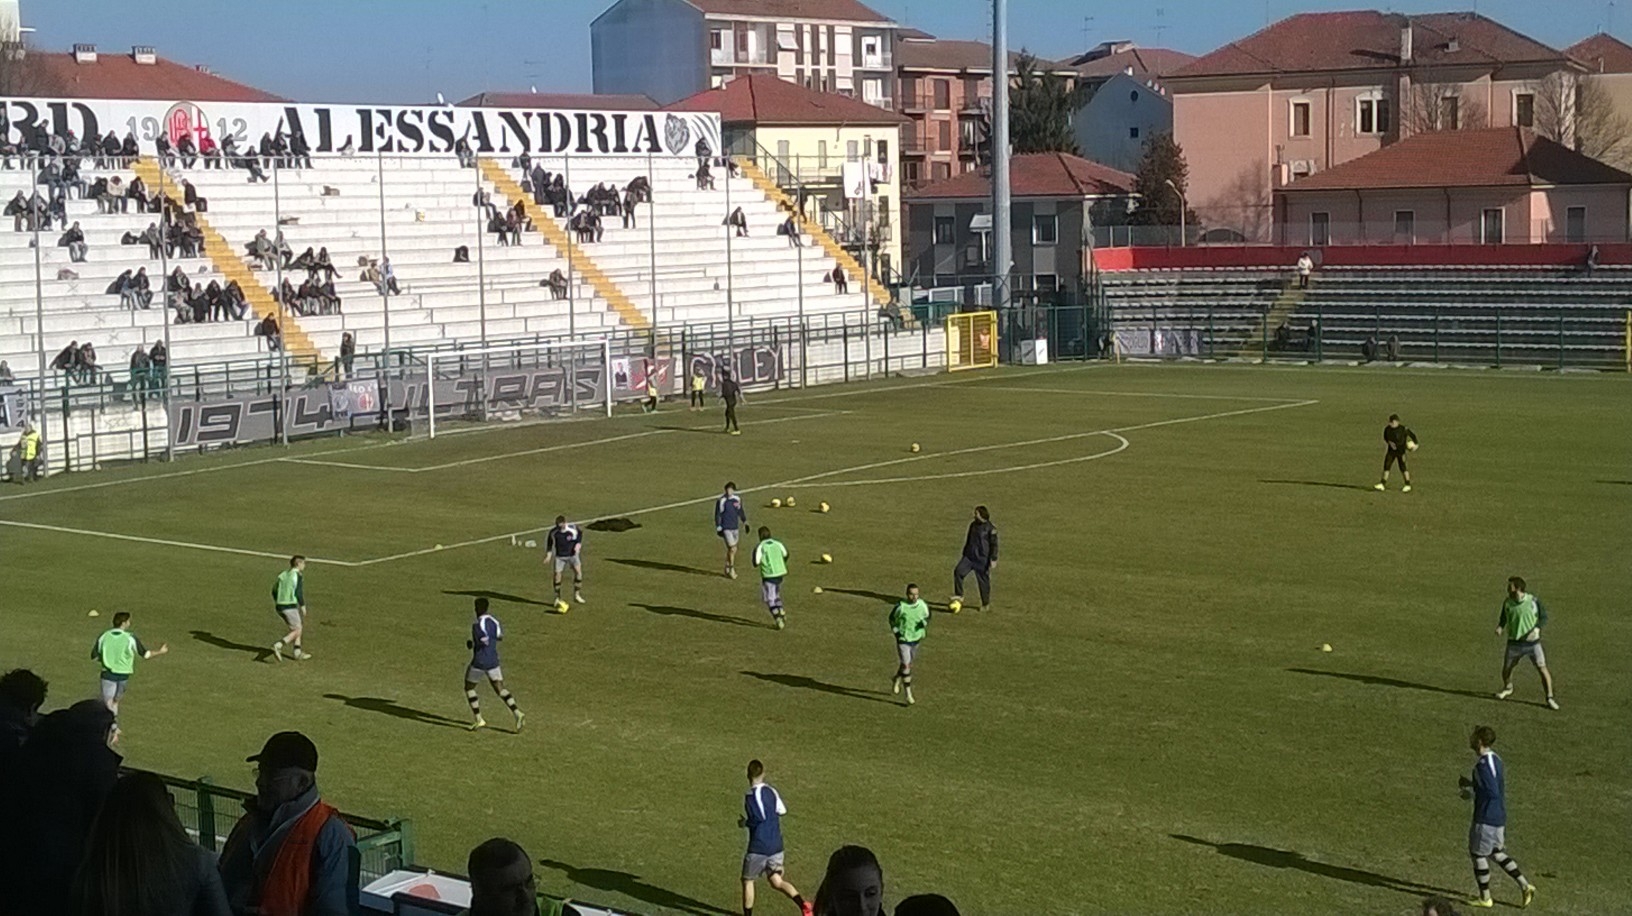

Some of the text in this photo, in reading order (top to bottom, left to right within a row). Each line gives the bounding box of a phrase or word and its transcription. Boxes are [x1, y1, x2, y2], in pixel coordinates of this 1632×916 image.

[270, 106, 663, 153] ALESSANDRIA
[175, 368, 603, 446] 1974 ULTRAS
